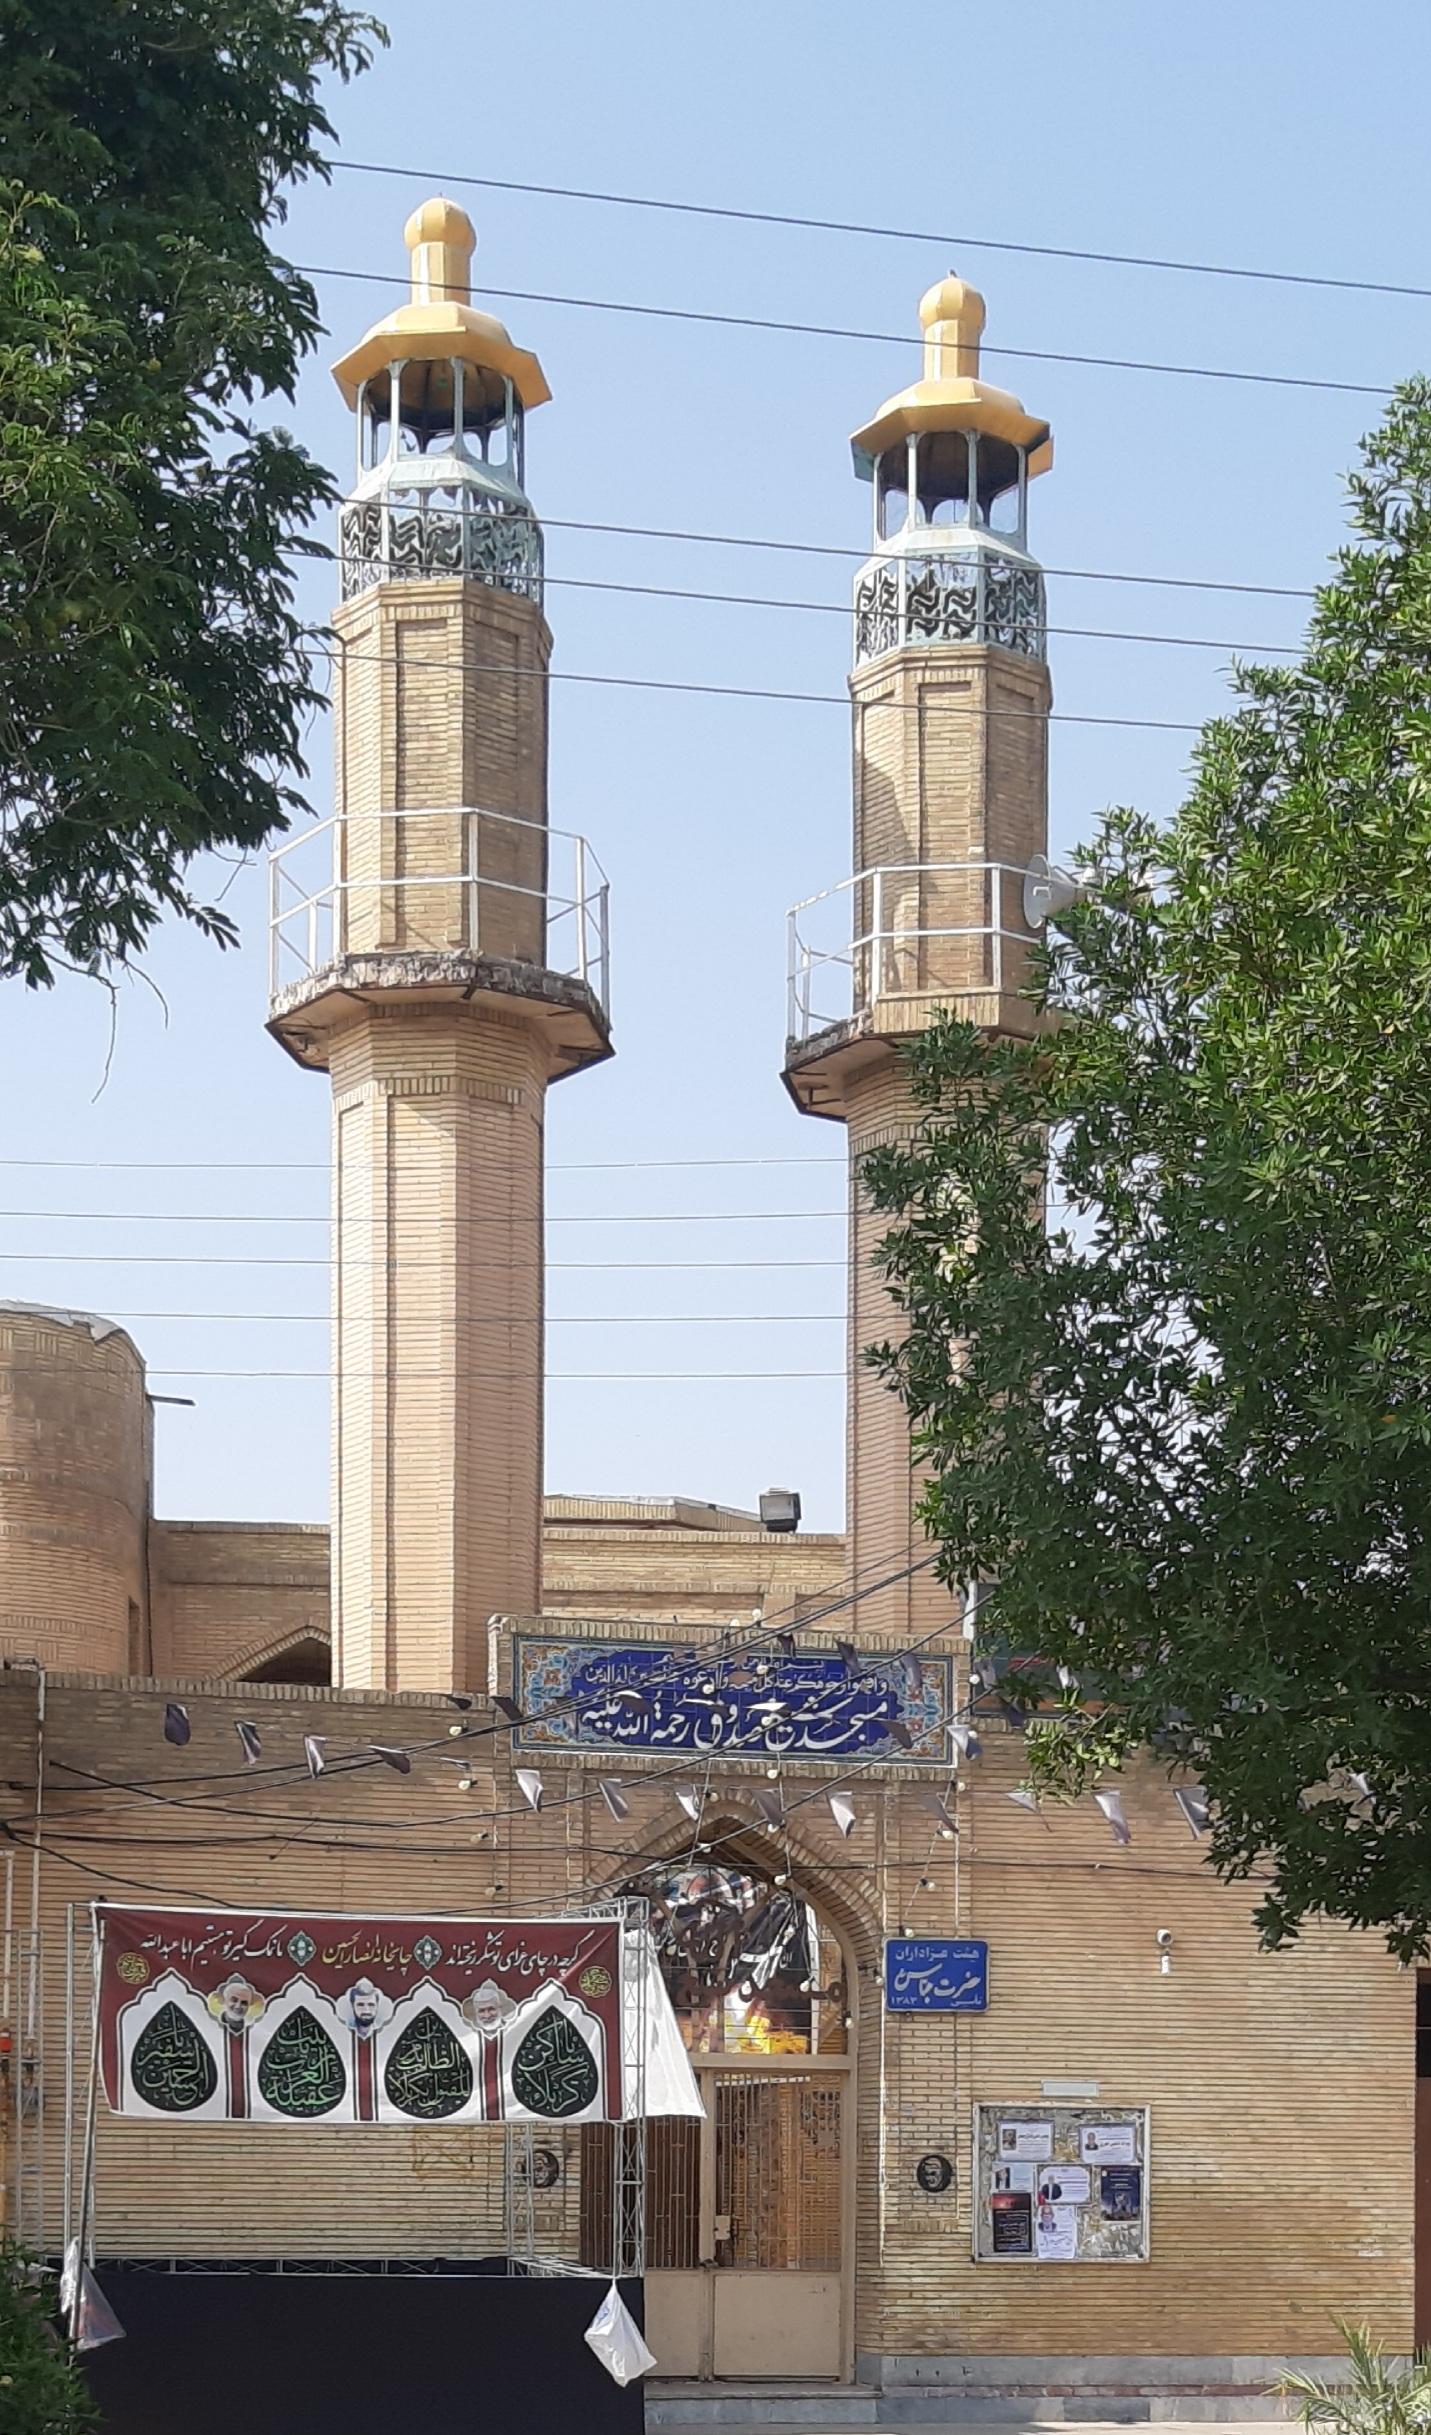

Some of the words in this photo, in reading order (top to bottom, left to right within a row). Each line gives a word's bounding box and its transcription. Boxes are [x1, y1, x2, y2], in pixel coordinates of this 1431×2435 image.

[612, 1710, 649, 1737] الله
[693, 1702, 763, 1750] صدوق
[793, 1701, 888, 1750] مسجد
[895, 1946, 948, 1962] عزاداران
[933, 1970, 981, 1999] حضرت
